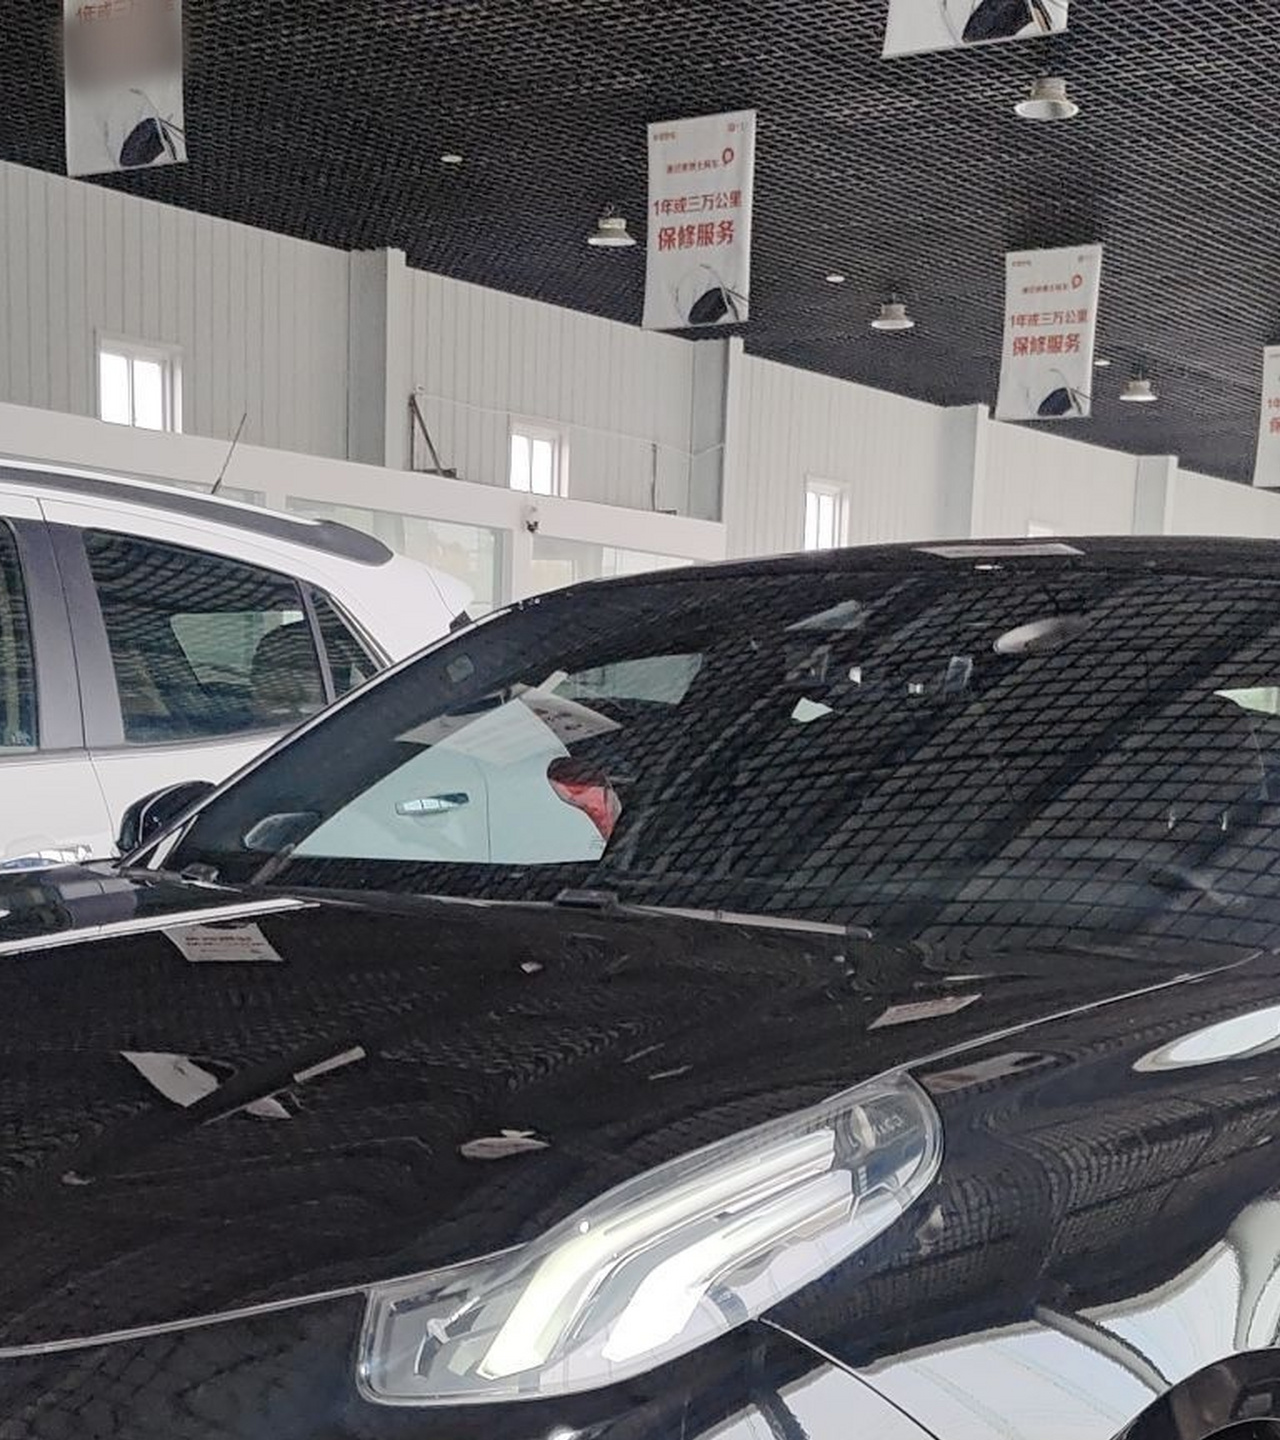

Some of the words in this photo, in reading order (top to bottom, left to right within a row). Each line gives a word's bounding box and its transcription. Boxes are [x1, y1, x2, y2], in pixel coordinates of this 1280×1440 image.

[653, 190, 742, 216] 1年或三万公里
[658, 220, 734, 252] 保修服务
[1013, 333, 1080, 357] 保修服务
